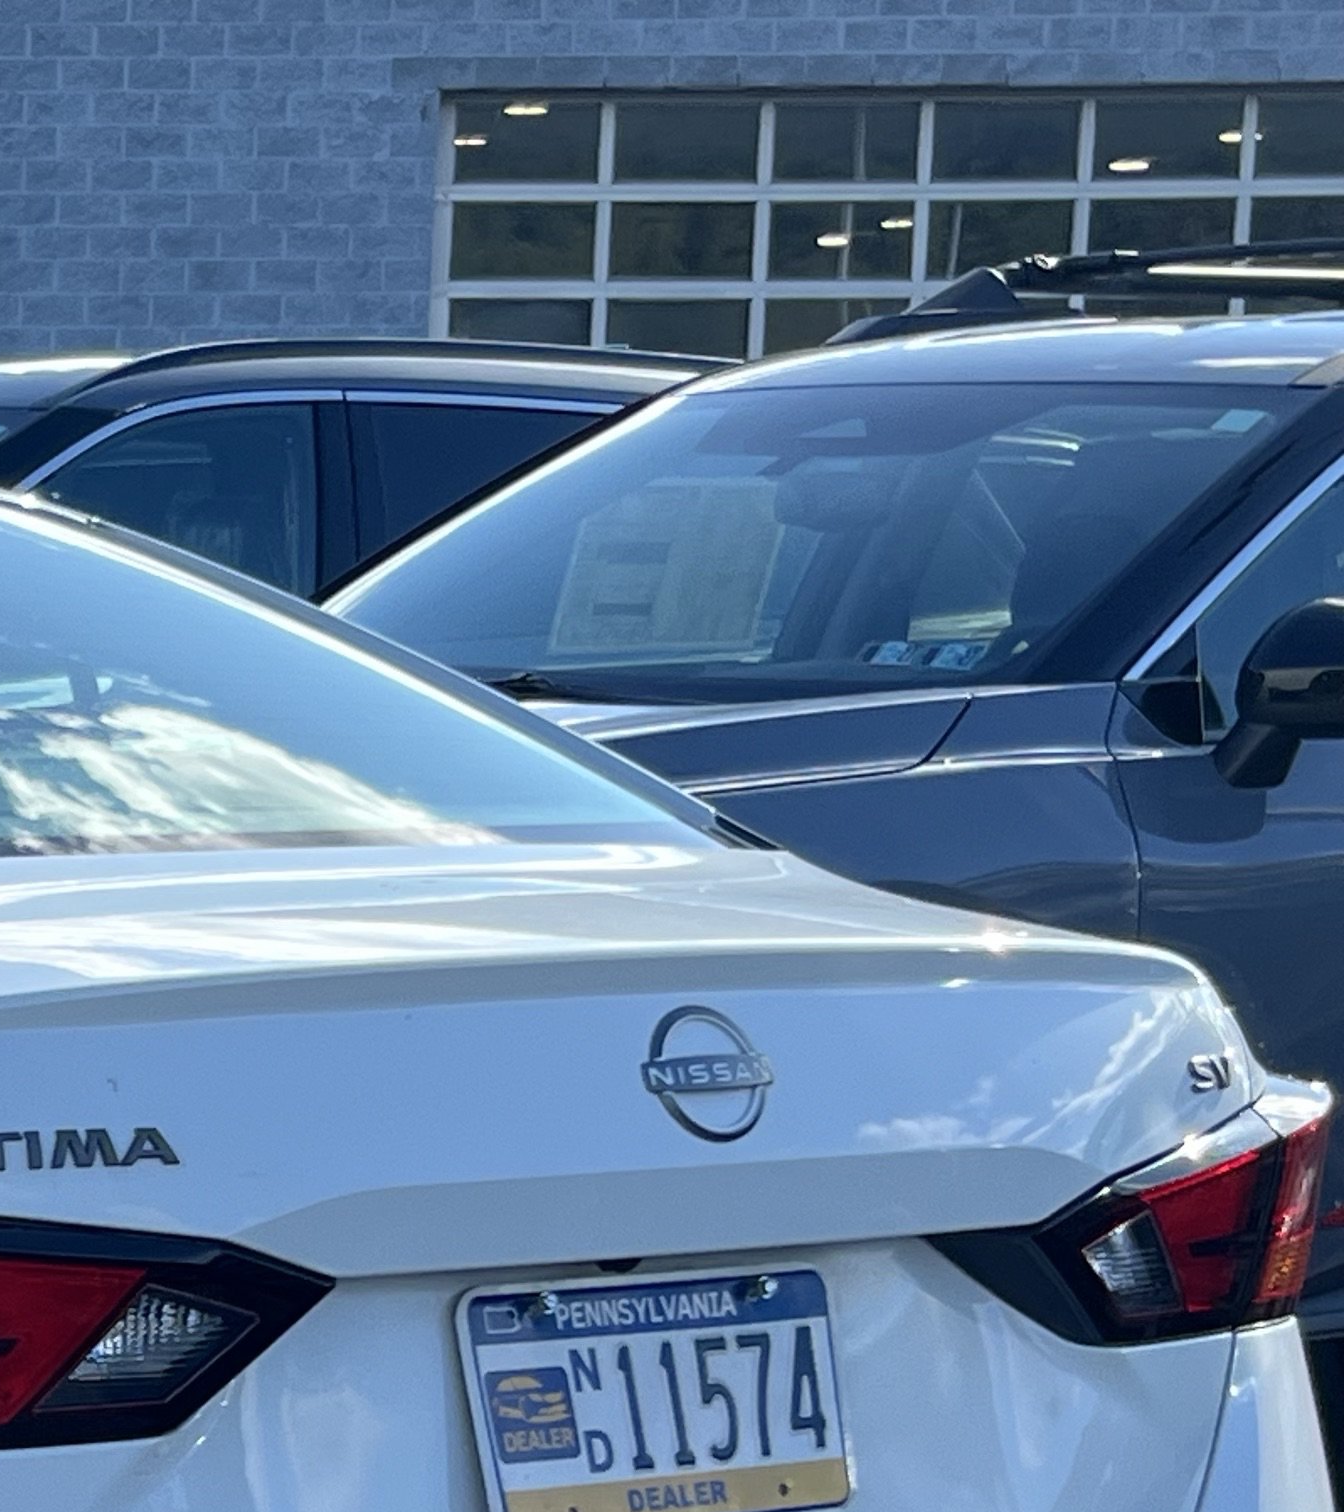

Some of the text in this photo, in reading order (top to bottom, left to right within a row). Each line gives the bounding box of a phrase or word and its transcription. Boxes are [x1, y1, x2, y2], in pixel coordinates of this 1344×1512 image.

[647, 1058, 772, 1087] NISSAN
[554, 1290, 738, 1331] PENNSYLVANIA
[504, 1427, 575, 1454] DEALER
[627, 1480, 728, 1512] DEALER
